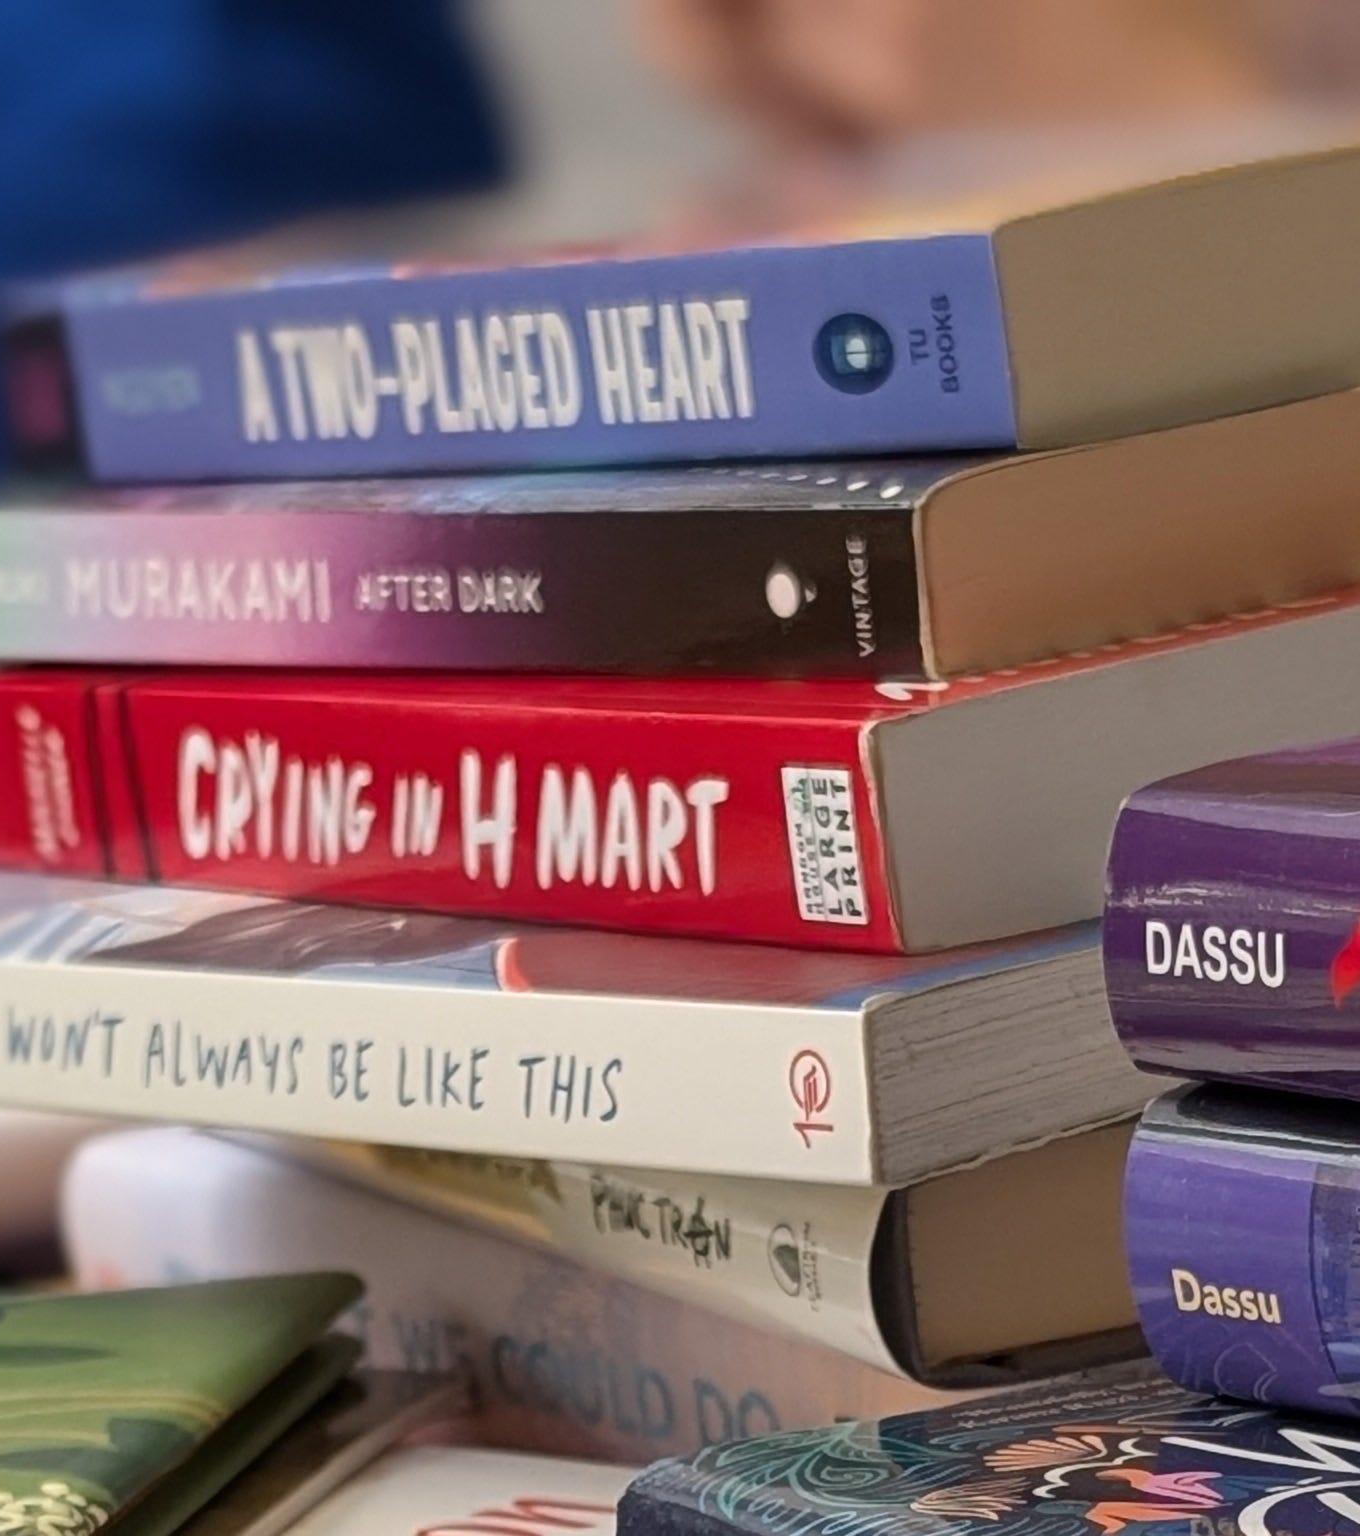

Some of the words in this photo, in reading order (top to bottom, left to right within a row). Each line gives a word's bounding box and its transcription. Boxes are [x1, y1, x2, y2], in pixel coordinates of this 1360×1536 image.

[237, 330, 279, 442] A
[586, 299, 754, 424] HEART
[908, 328, 929, 366] TU
[930, 294, 960, 394] BOOKS
[62, 557, 332, 624] MURAKAMI
[355, 568, 451, 613] AFTER
[458, 566, 544, 614] DARK
[845, 531, 877, 659] VINTAGE
[177, 726, 376, 867] CRYING
[390, 770, 442, 858] IN
[460, 746, 517, 890] H
[536, 761, 731, 897] MART
[811, 778, 844, 916] LARGE
[830, 778, 862, 917] PRINT
[1144, 919, 1285, 989] DASSU
[7, 1003, 126, 1080] WON'T
[143, 1019, 303, 1096] ALWAYS
[327, 1040, 375, 1102] BE
[397, 1046, 491, 1113] LIKE
[518, 1054, 622, 1125] THIS
[1171, 1268, 1283, 1325] Dassu
